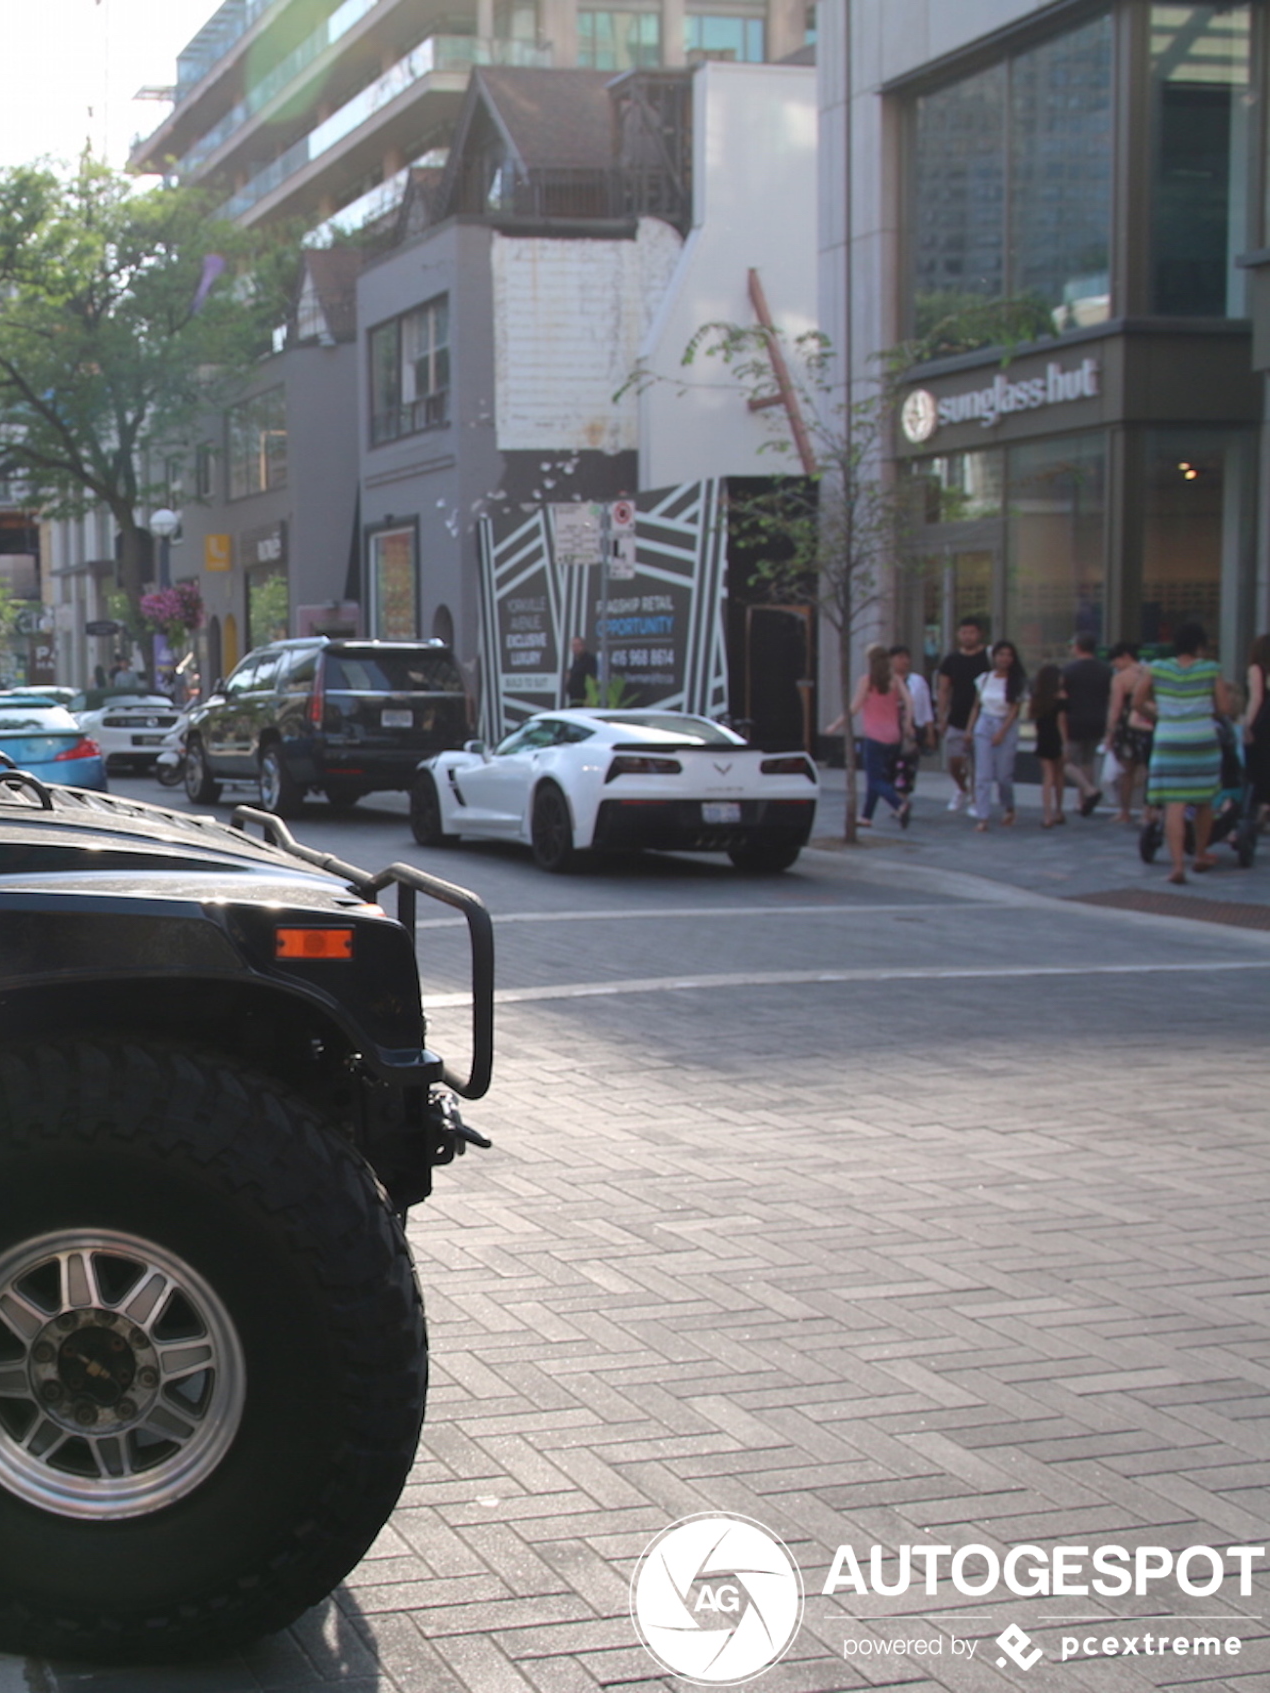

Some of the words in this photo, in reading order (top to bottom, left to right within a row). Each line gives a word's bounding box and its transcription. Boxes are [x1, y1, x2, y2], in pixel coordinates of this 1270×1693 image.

[938, 374, 1046, 428] sunglass
[1046, 358, 1100, 403] hut
[596, 597, 640, 614] FAGSHIP
[641, 595, 675, 612] RETAIL
[506, 632, 547, 649] EXCLUSIVE
[511, 651, 542, 665] LUXURY
